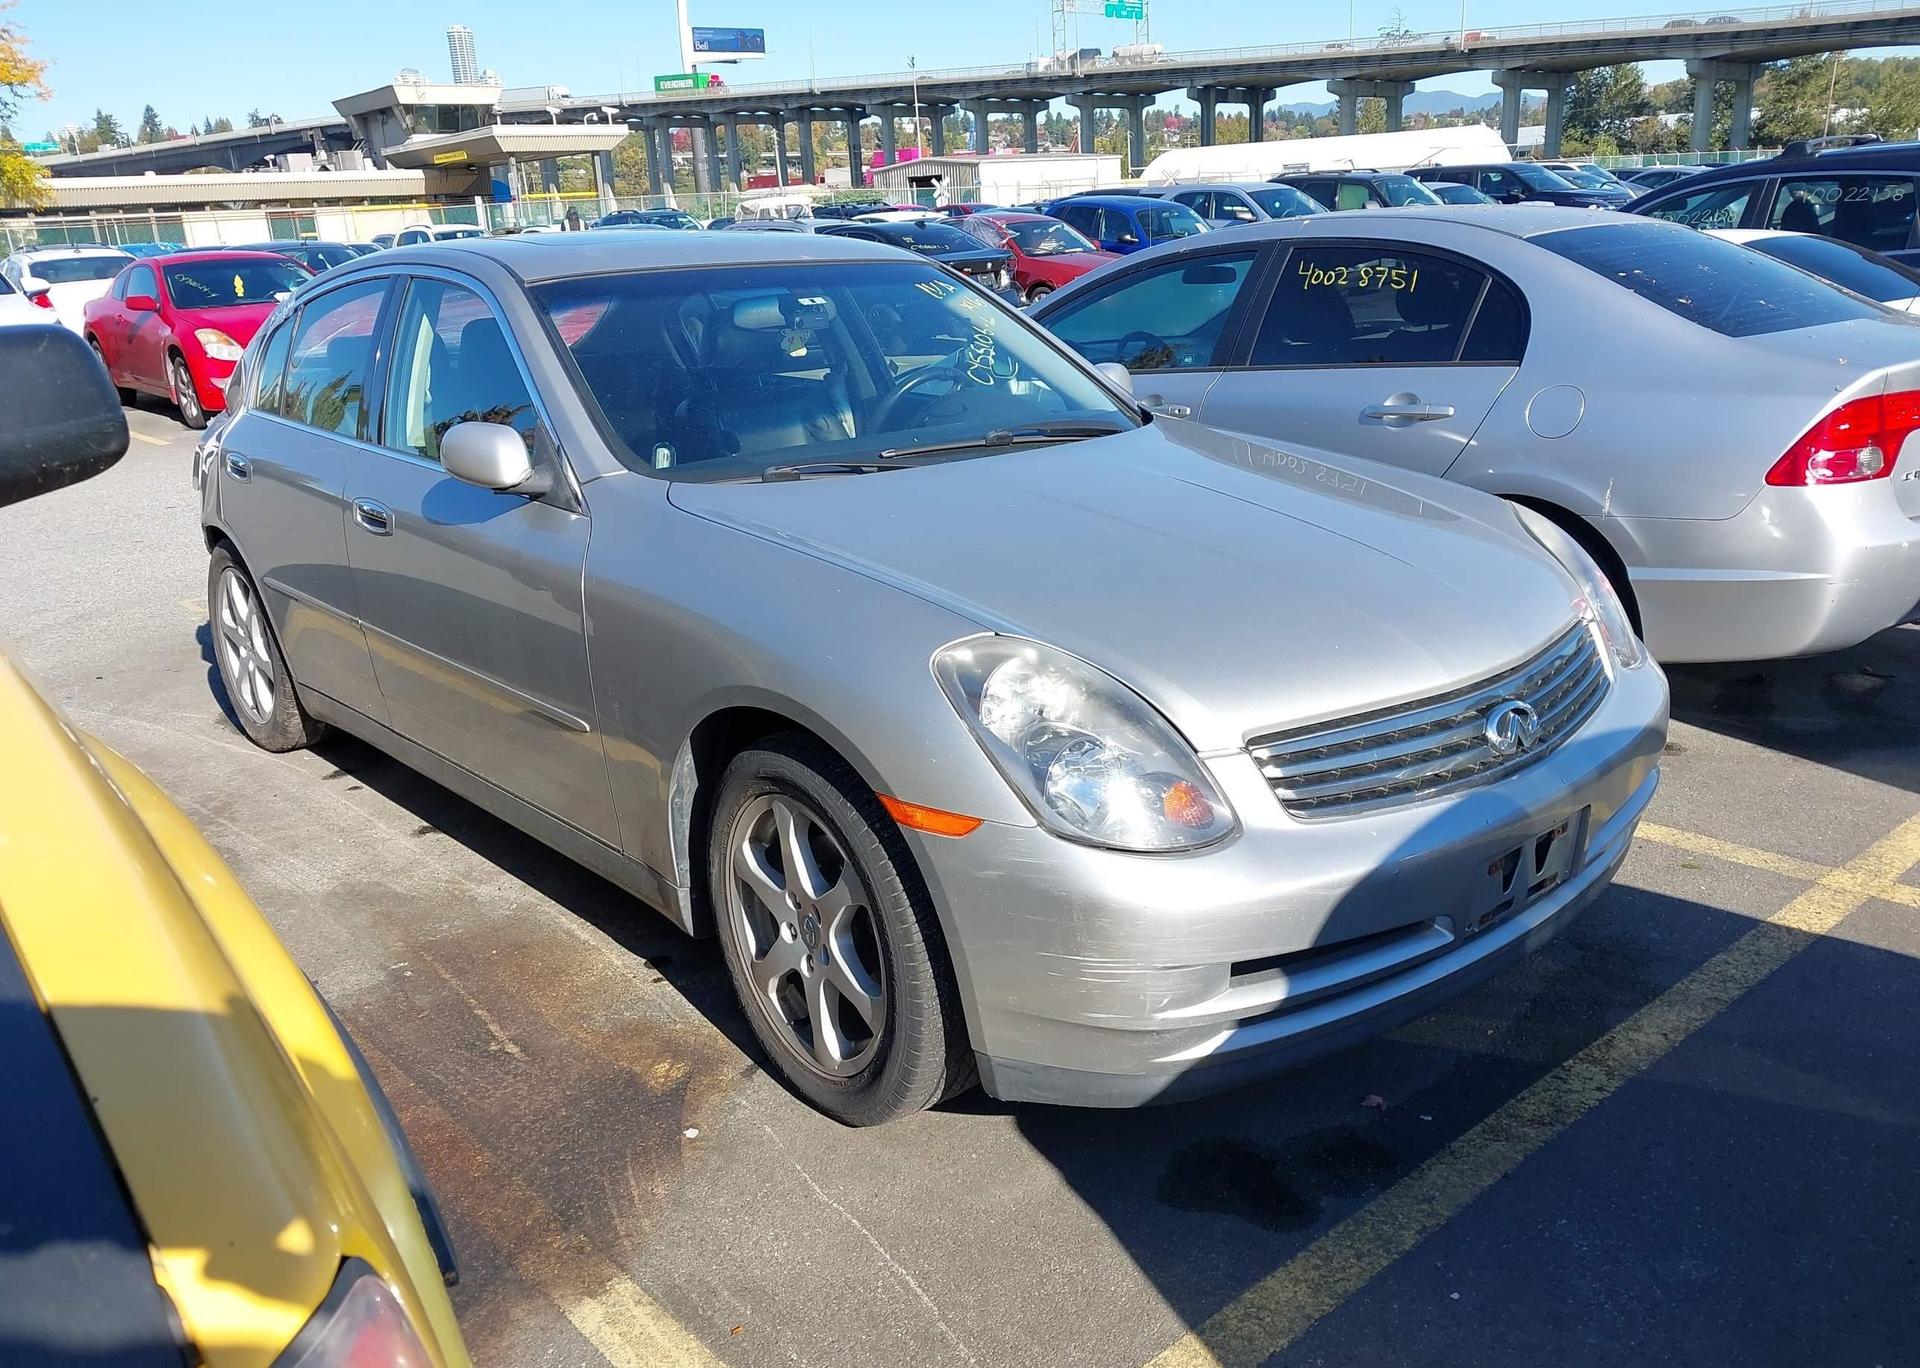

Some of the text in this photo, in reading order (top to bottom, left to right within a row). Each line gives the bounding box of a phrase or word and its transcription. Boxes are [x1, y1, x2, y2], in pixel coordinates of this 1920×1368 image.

[695, 41, 709, 50] Bell
[660, 79, 694, 89] EVERGREEN
[1298, 259, 1418, 293] 4002 8751
